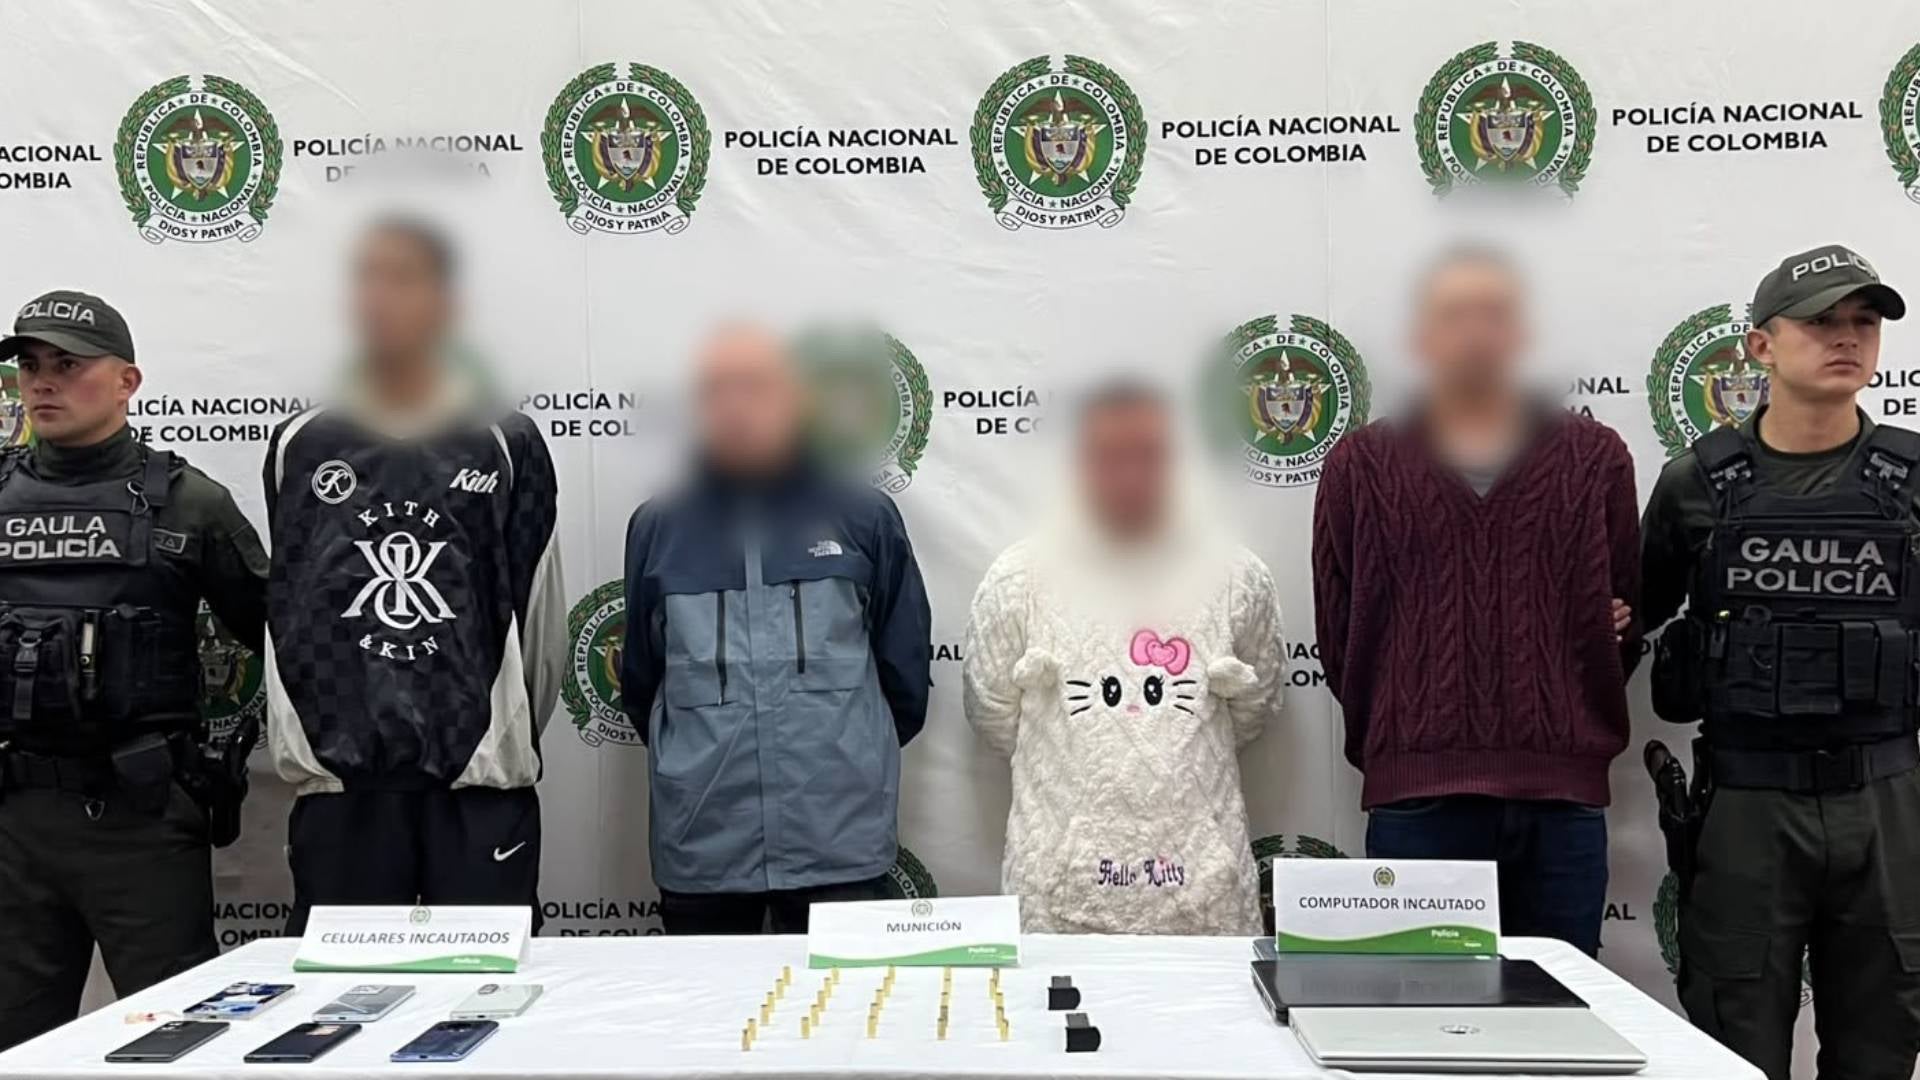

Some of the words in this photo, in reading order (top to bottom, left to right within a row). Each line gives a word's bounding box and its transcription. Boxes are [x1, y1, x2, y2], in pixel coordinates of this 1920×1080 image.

[1438, 68, 1483, 140] REPUBLICA
[1497, 62, 1517, 71] DE
[1531, 68, 1574, 137] COLOMBIA
[1904, 76, 1920, 126] REPUB
[563, 89, 603, 158] REPUBLICA
[616, 82, 635, 92] DE
[648, 90, 690, 158] COLOMBIA
[993, 82, 1037, 153] REPUBLICA
[1050, 75, 1069, 85] DE
[1083, 82, 1125, 150] COLOMBIA
[1613, 102, 1716, 126] POLICÍA
[1723, 101, 1863, 123] NACIONAL
[136, 101, 177, 170] REPUBLICA
[189, 94, 208, 104] DE
[221, 101, 262, 167] COLOMBIA
[724, 126, 821, 148] POLICÍA
[828, 128, 958, 147] NACIONAL
[1162, 115, 1261, 139] POLICÍA
[1269, 115, 1400, 136] NACIONAL
[293, 134, 387, 157] POLICÍA
[1647, 135, 1679, 153] DE
[1688, 131, 1827, 152] COLOMBIA
[758, 158, 788, 175] DE
[795, 156, 926, 175] COLOMBIA
[1195, 148, 1227, 165] DE
[1234, 144, 1367, 164] COLOMBIA
[628, 172, 684, 214] NACIONAL
[1060, 166, 1120, 209] NACIONAL
[201, 181, 257, 222] NACIONAL
[627, 210, 671, 230] PATRIA
[1060, 204, 1105, 224] PATRIA
[201, 219, 244, 238] PATRIA
[1792, 253, 1876, 281] POLIC
[17, 300, 95, 325] OLICÍA
[1276, 334, 1296, 344] DE
[1309, 342, 1350, 410] COLOMBIA
[1671, 331, 1717, 402] REPUBLICA
[1867, 370, 1920, 388] OLIC
[126, 395, 184, 416] LICÍA
[519, 388, 611, 410] POLICÍA
[893, 371, 911, 418] OMBIA
[943, 386, 1040, 408] POLICÍA
[1884, 398, 1916, 416] DE
[160, 425, 268, 442] COLOMBI
[552, 420, 581, 437] DE
[976, 417, 1007, 435] DE
[1285, 424, 1344, 467] NACIONAL
[450, 467, 499, 493] Kith
[1285, 467, 1322, 483] PATRI
[5, 515, 106, 537] GAULA
[358, 500, 441, 528] KITH
[0, 532, 121, 560] POLICÍA
[1741, 537, 1884, 566] GAULA
[1727, 564, 1896, 596] POLICÍA
[577, 604, 616, 672] REPUBLICA
[1098, 859, 1137, 886] Hello
[1144, 858, 1184, 887] Kitty
[542, 897, 621, 919] OLICÍA
[1299, 897, 1399, 909] COMPUTADOR
[1403, 898, 1486, 911] INCAUTADO
[321, 932, 405, 944] CELULARES
[409, 932, 510, 944] INCAUTADOS
[886, 919, 962, 933] MUNICIÓN
